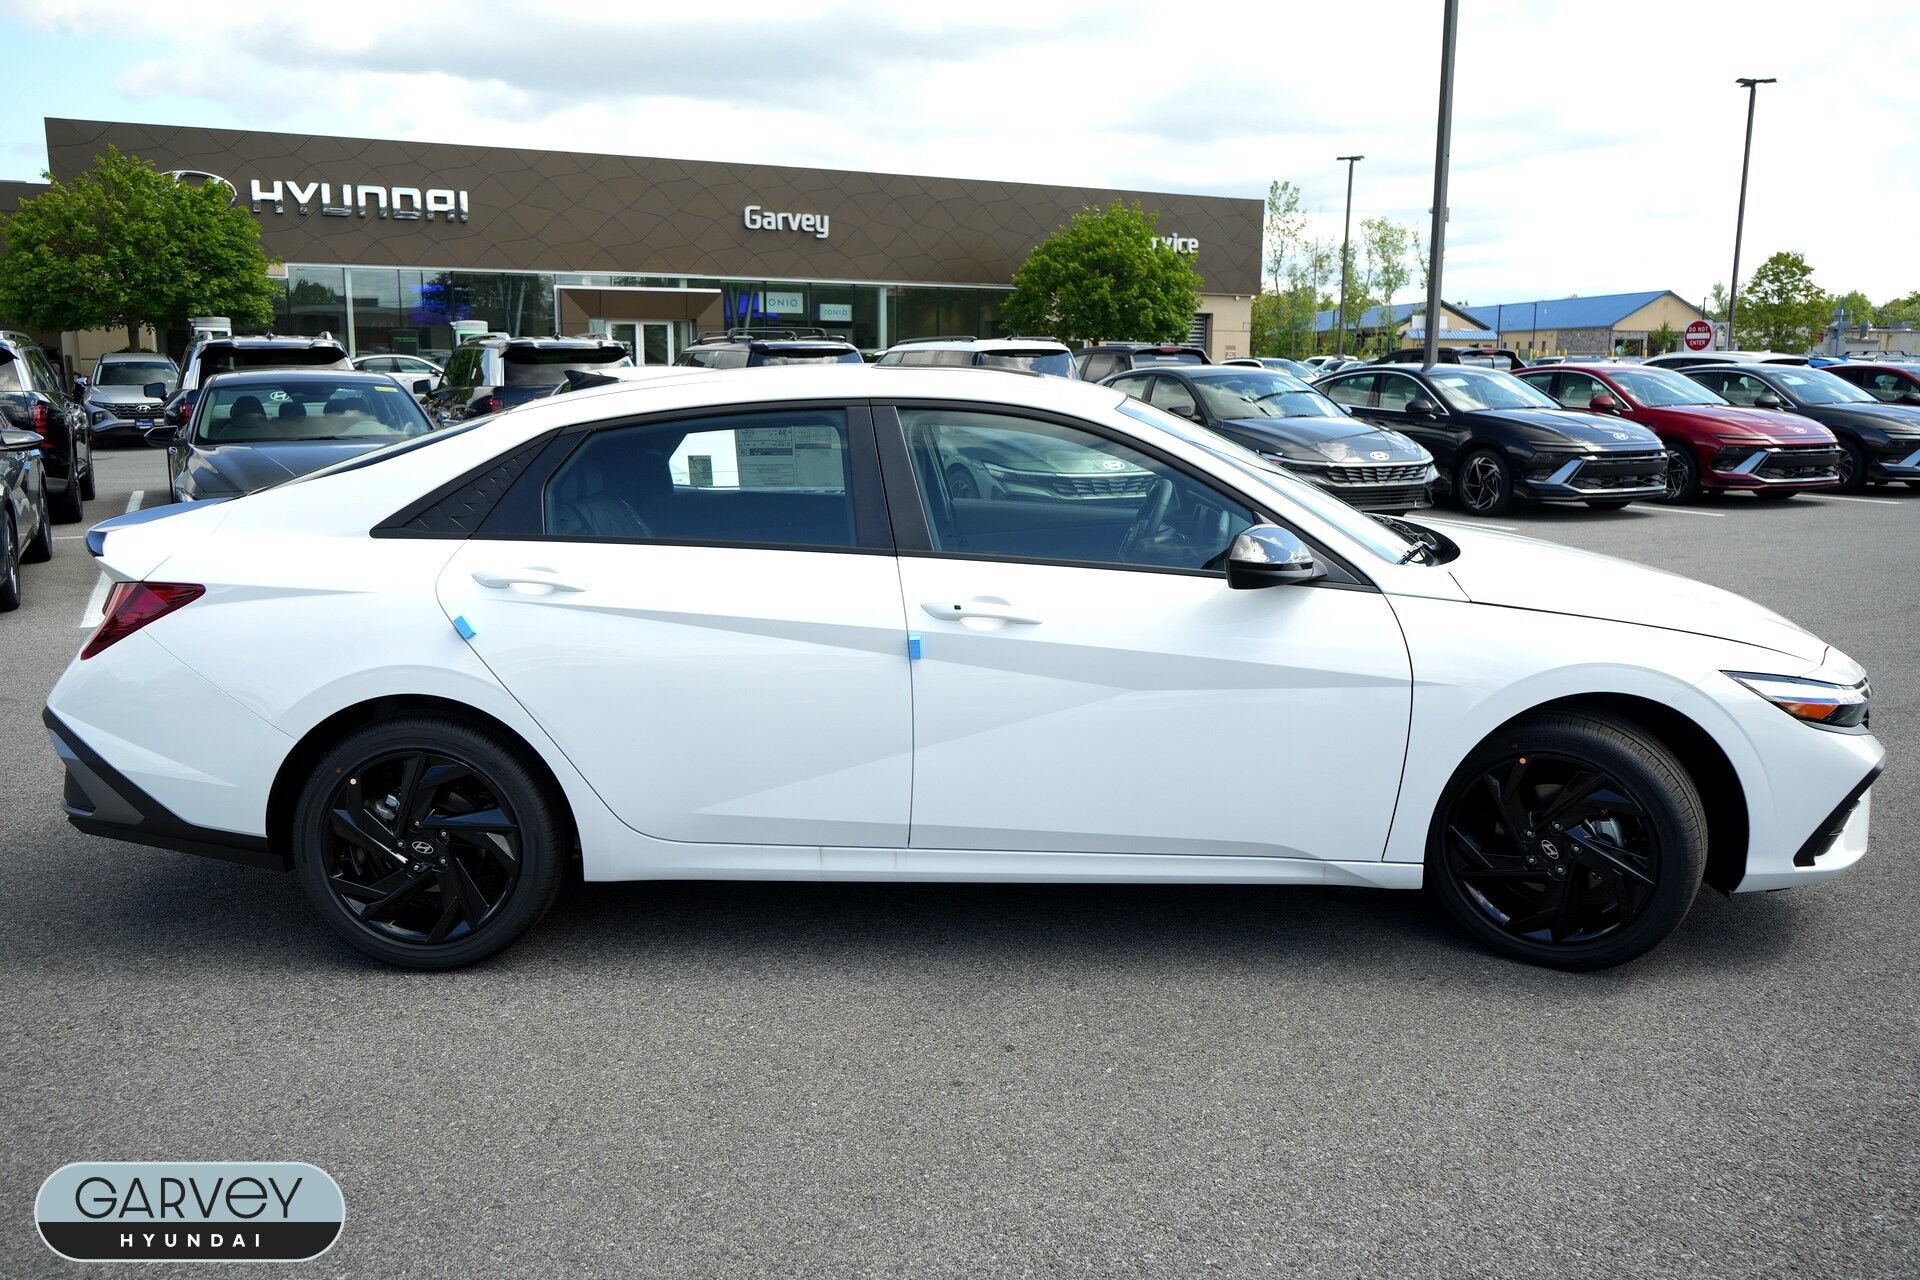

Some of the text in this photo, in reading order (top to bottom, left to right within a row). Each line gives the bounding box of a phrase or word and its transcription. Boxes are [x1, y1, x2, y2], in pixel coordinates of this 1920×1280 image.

[250, 179, 469, 223] HYUNDAI
[744, 205, 829, 238] Garvey
[1151, 232, 1199, 253] rvice
[768, 298, 798, 307] ONIQ
